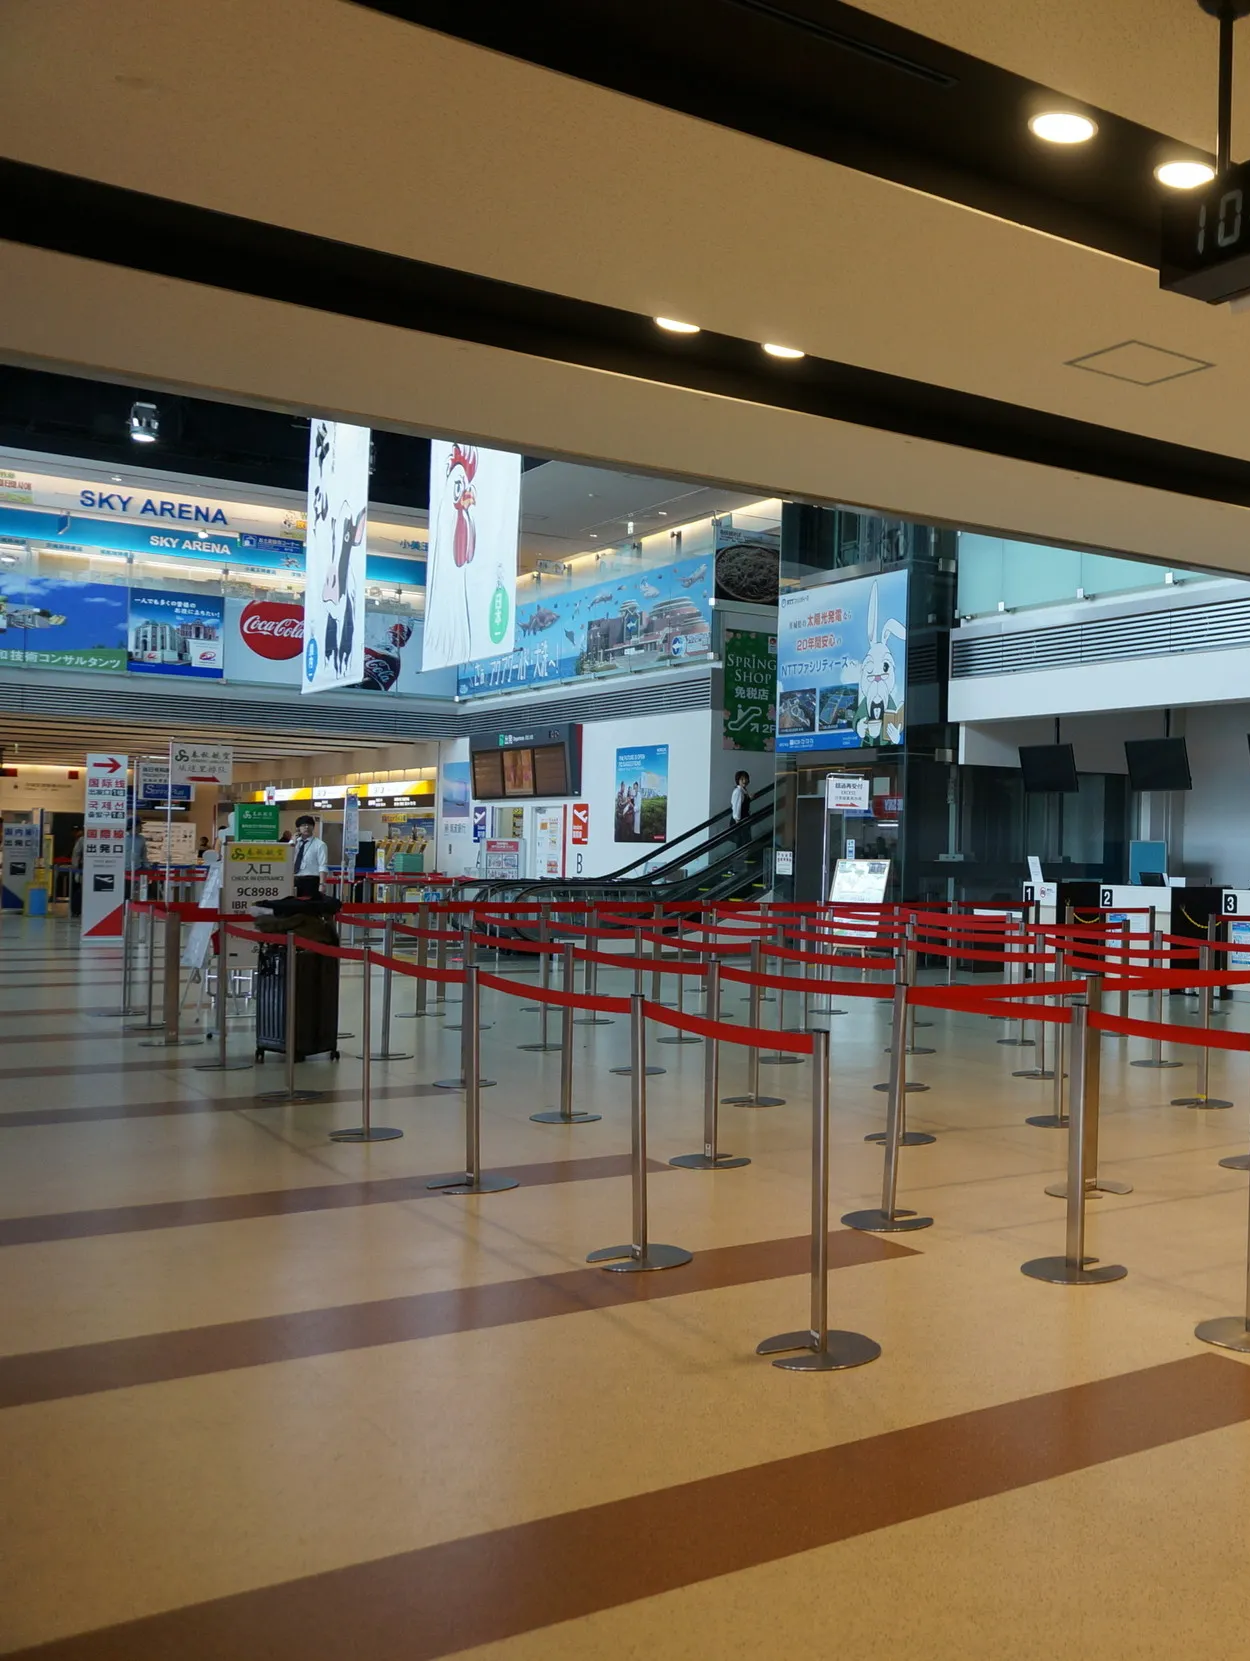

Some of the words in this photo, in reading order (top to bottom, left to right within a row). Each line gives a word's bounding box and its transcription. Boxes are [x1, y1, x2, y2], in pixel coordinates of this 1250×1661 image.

[80, 490, 133, 512] SKY
[140, 499, 229, 526] ARENA
[150, 535, 180, 549] SKY
[182, 540, 231, 555] ARENA
[243, 615, 304, 639] Coca-Cola
[727, 654, 777, 671] SPRING
[735, 669, 772, 684] SHOP
[735, 686, 769, 700] 免税店
[88, 778, 126, 788] 国际线
[88, 801, 124, 811] 국제선
[87, 829, 125, 839] 国際線
[86, 844, 124, 853] 出発口
[246, 864, 271, 874] 入口
[576, 853, 583, 874] B
[237, 887, 279, 897] 9C8988
[1026, 887, 1031, 900] 1
[1103, 891, 1111, 905] 2
[231, 901, 248, 909] IBR
[1226, 896, 1234, 911] 3
